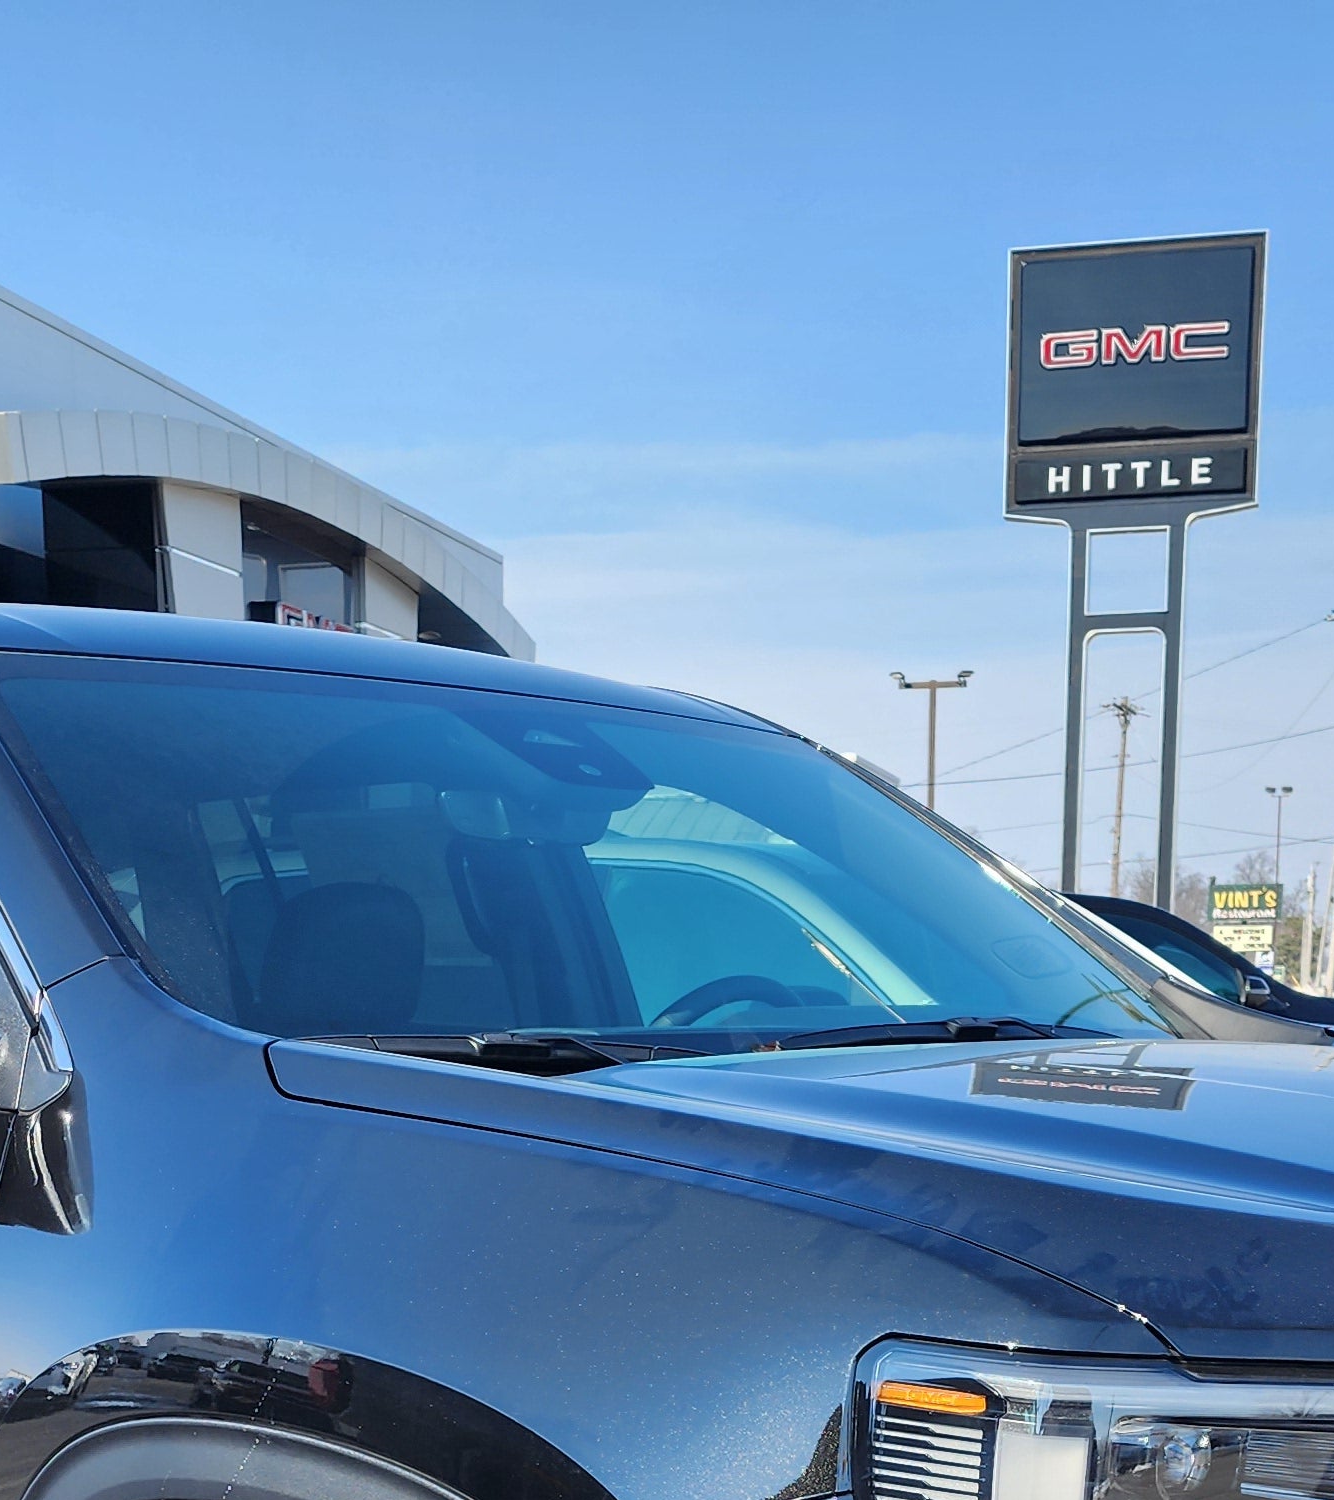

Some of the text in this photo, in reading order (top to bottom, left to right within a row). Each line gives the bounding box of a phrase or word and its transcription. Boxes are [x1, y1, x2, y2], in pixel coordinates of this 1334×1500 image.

[1040, 320, 1230, 370] GMC
[1047, 457, 1213, 494] HITTLE
[1214, 888, 1277, 909] VINT'S
